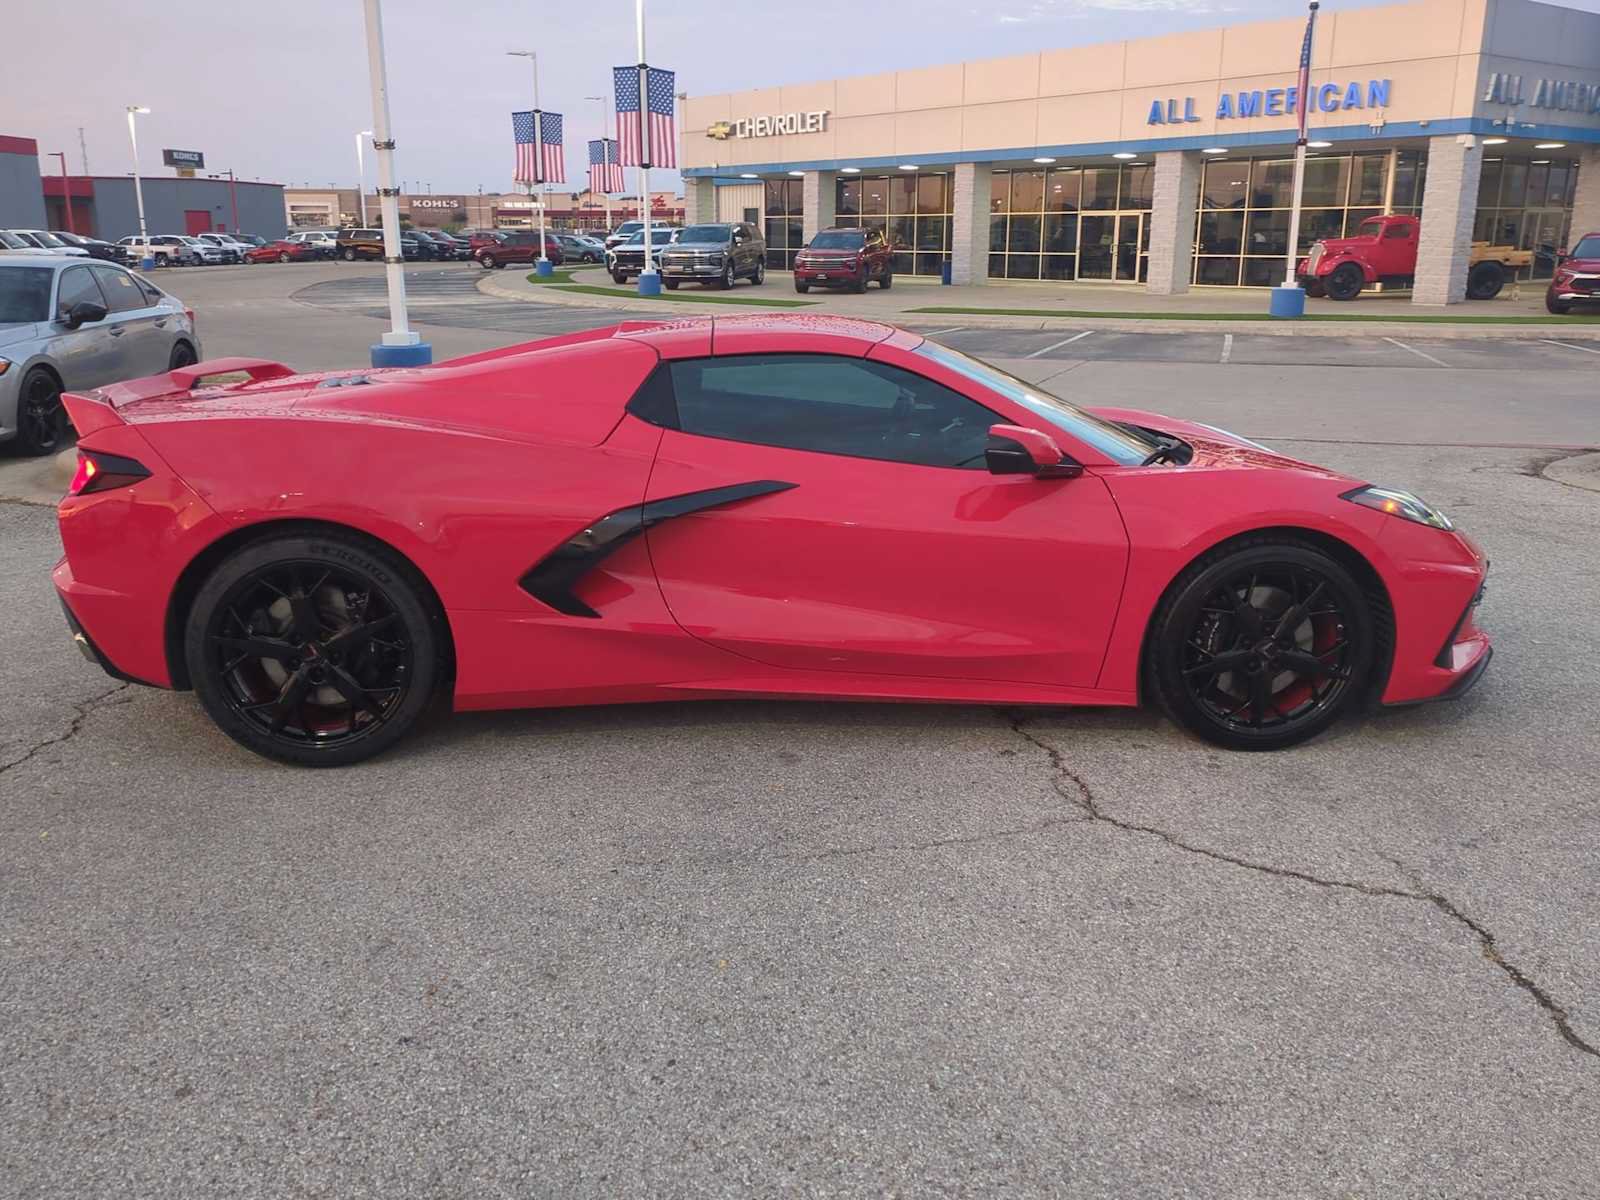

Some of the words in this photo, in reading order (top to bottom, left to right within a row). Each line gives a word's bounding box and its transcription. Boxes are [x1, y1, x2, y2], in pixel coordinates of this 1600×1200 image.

[1147, 96, 1201, 125] ALL
[1216, 79, 1391, 119] AMERICAN
[1482, 73, 1524, 105] ALL
[735, 110, 829, 138] CHEVROLET
[412, 199, 459, 208] KOHL'S
